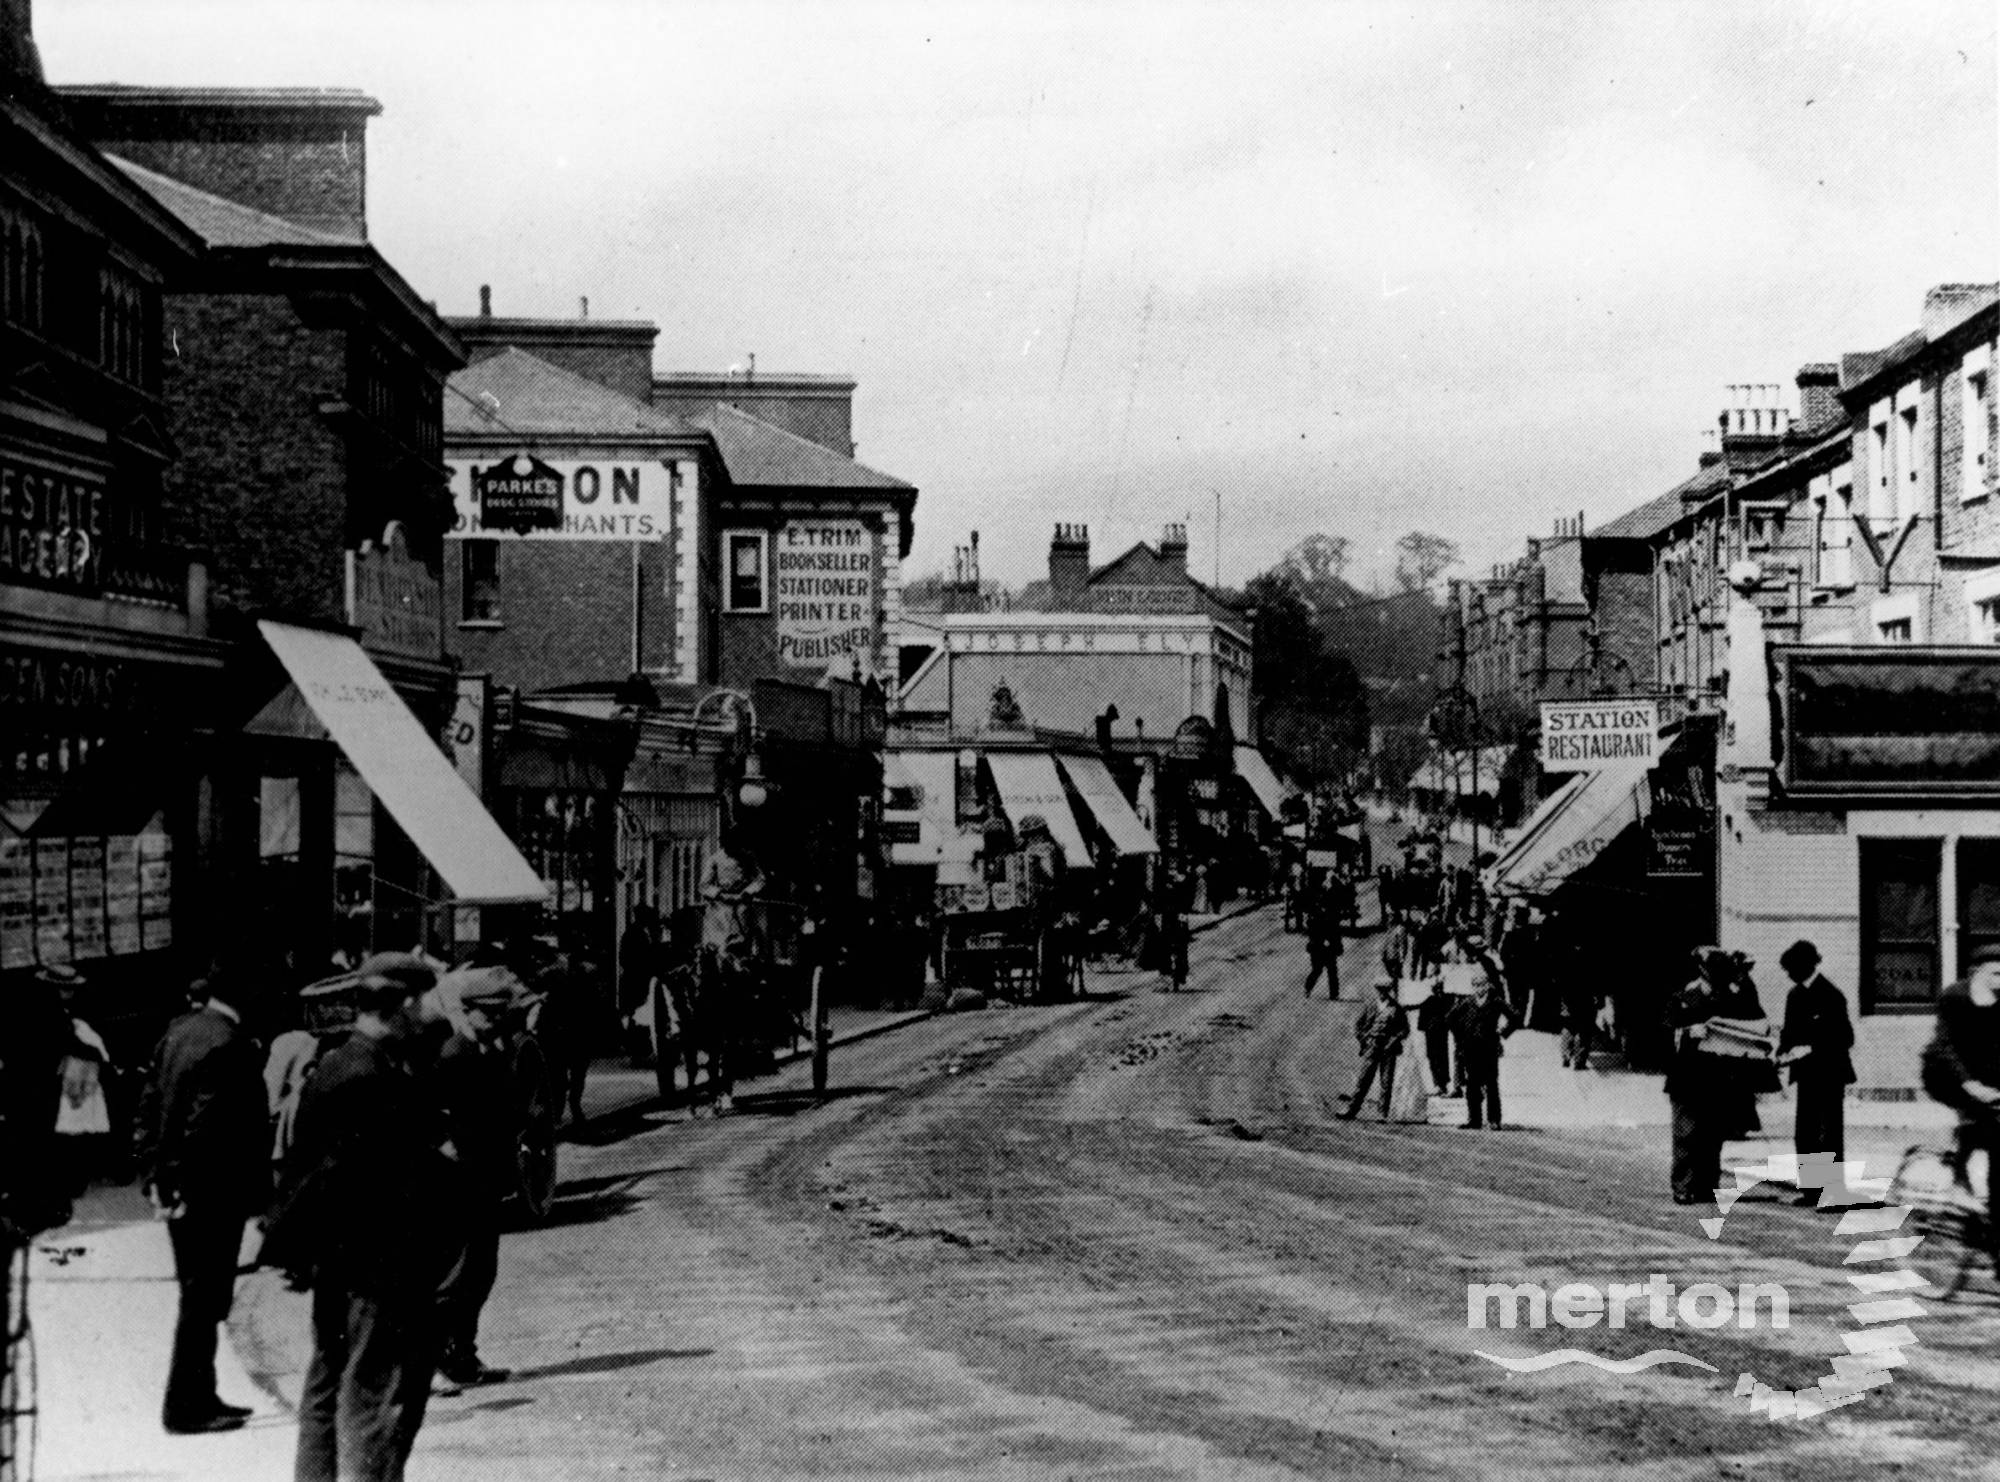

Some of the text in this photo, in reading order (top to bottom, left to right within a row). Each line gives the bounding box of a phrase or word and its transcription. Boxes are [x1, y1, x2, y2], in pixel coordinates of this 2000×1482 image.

[0, 467, 103, 537] ESTATE
[779, 552, 871, 572] BOOKSELLER
[779, 577, 868, 597] STATIONER
[778, 626, 871, 659] PUBLISHER
[1548, 710, 1652, 731] STATION
[1548, 732, 1653, 760] RESTAURANT
